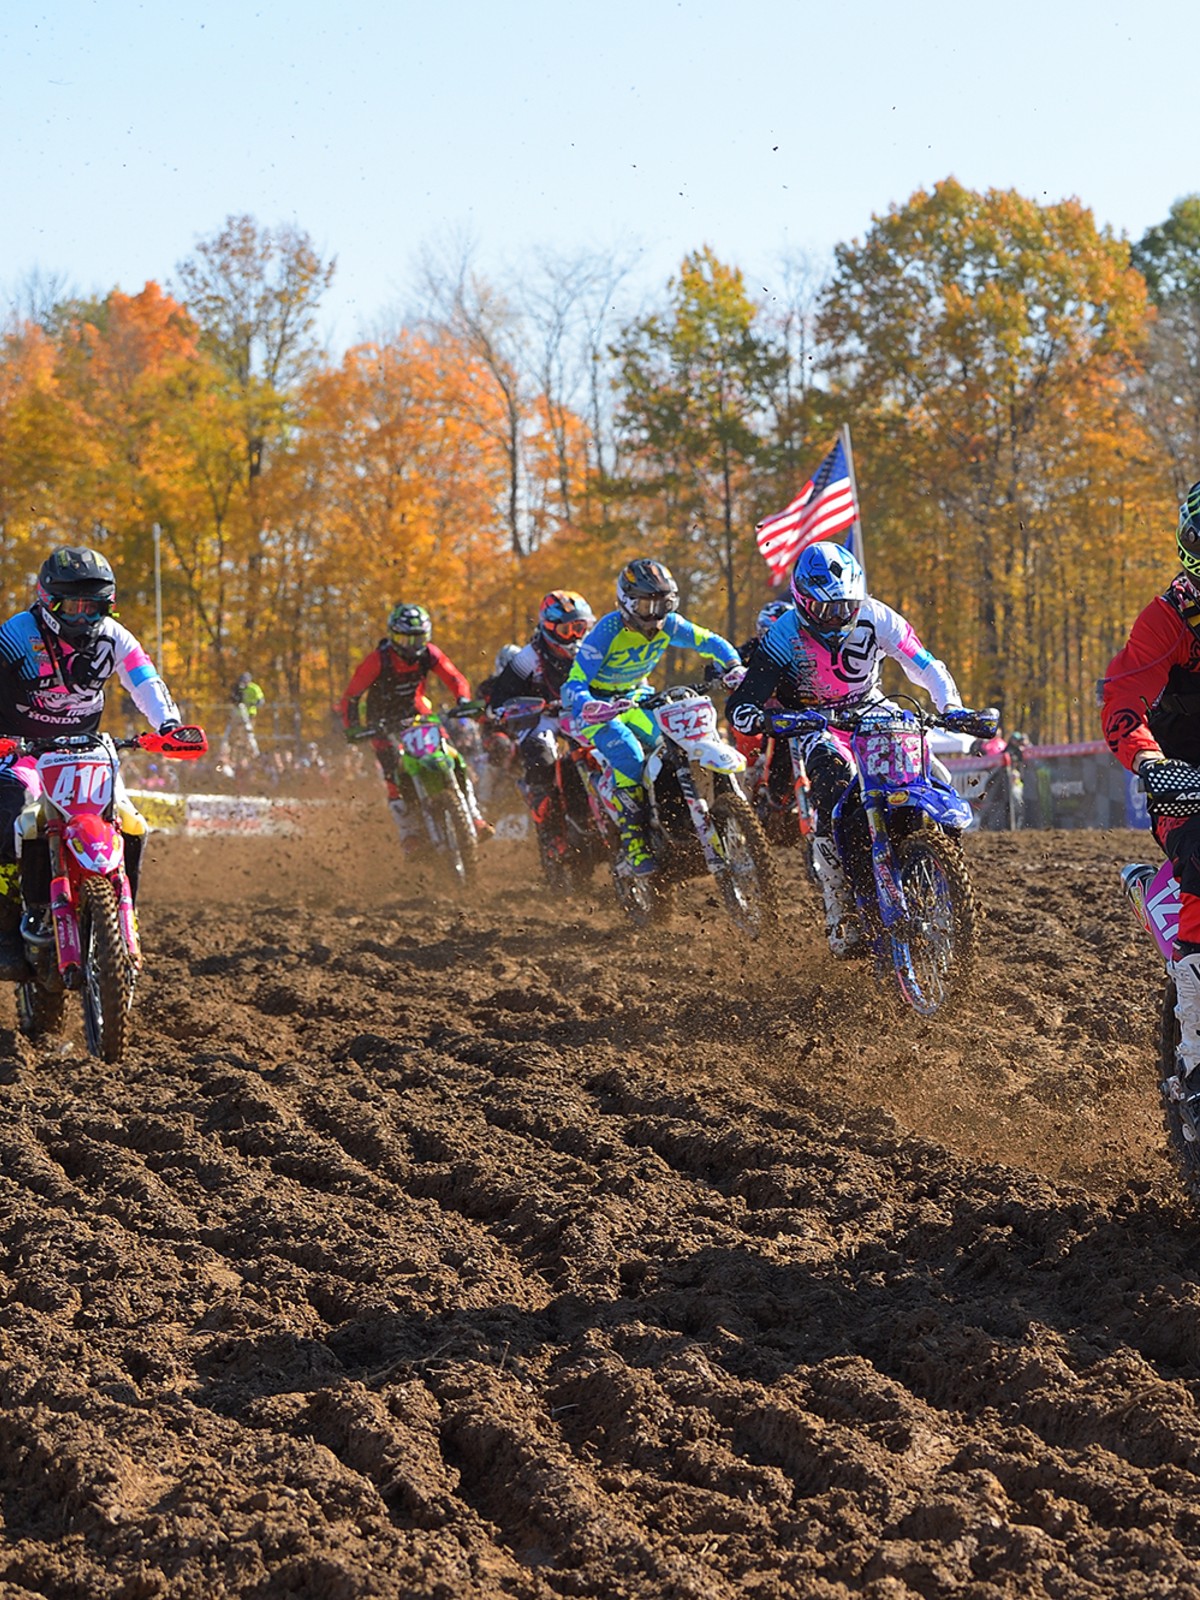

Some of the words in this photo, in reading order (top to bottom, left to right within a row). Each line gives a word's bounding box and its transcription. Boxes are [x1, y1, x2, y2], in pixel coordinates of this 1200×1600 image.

[601, 638, 666, 668] FXR
[28, 709, 81, 725] HONDA
[668, 708, 713, 739] 523
[51, 763, 112, 806] 410
